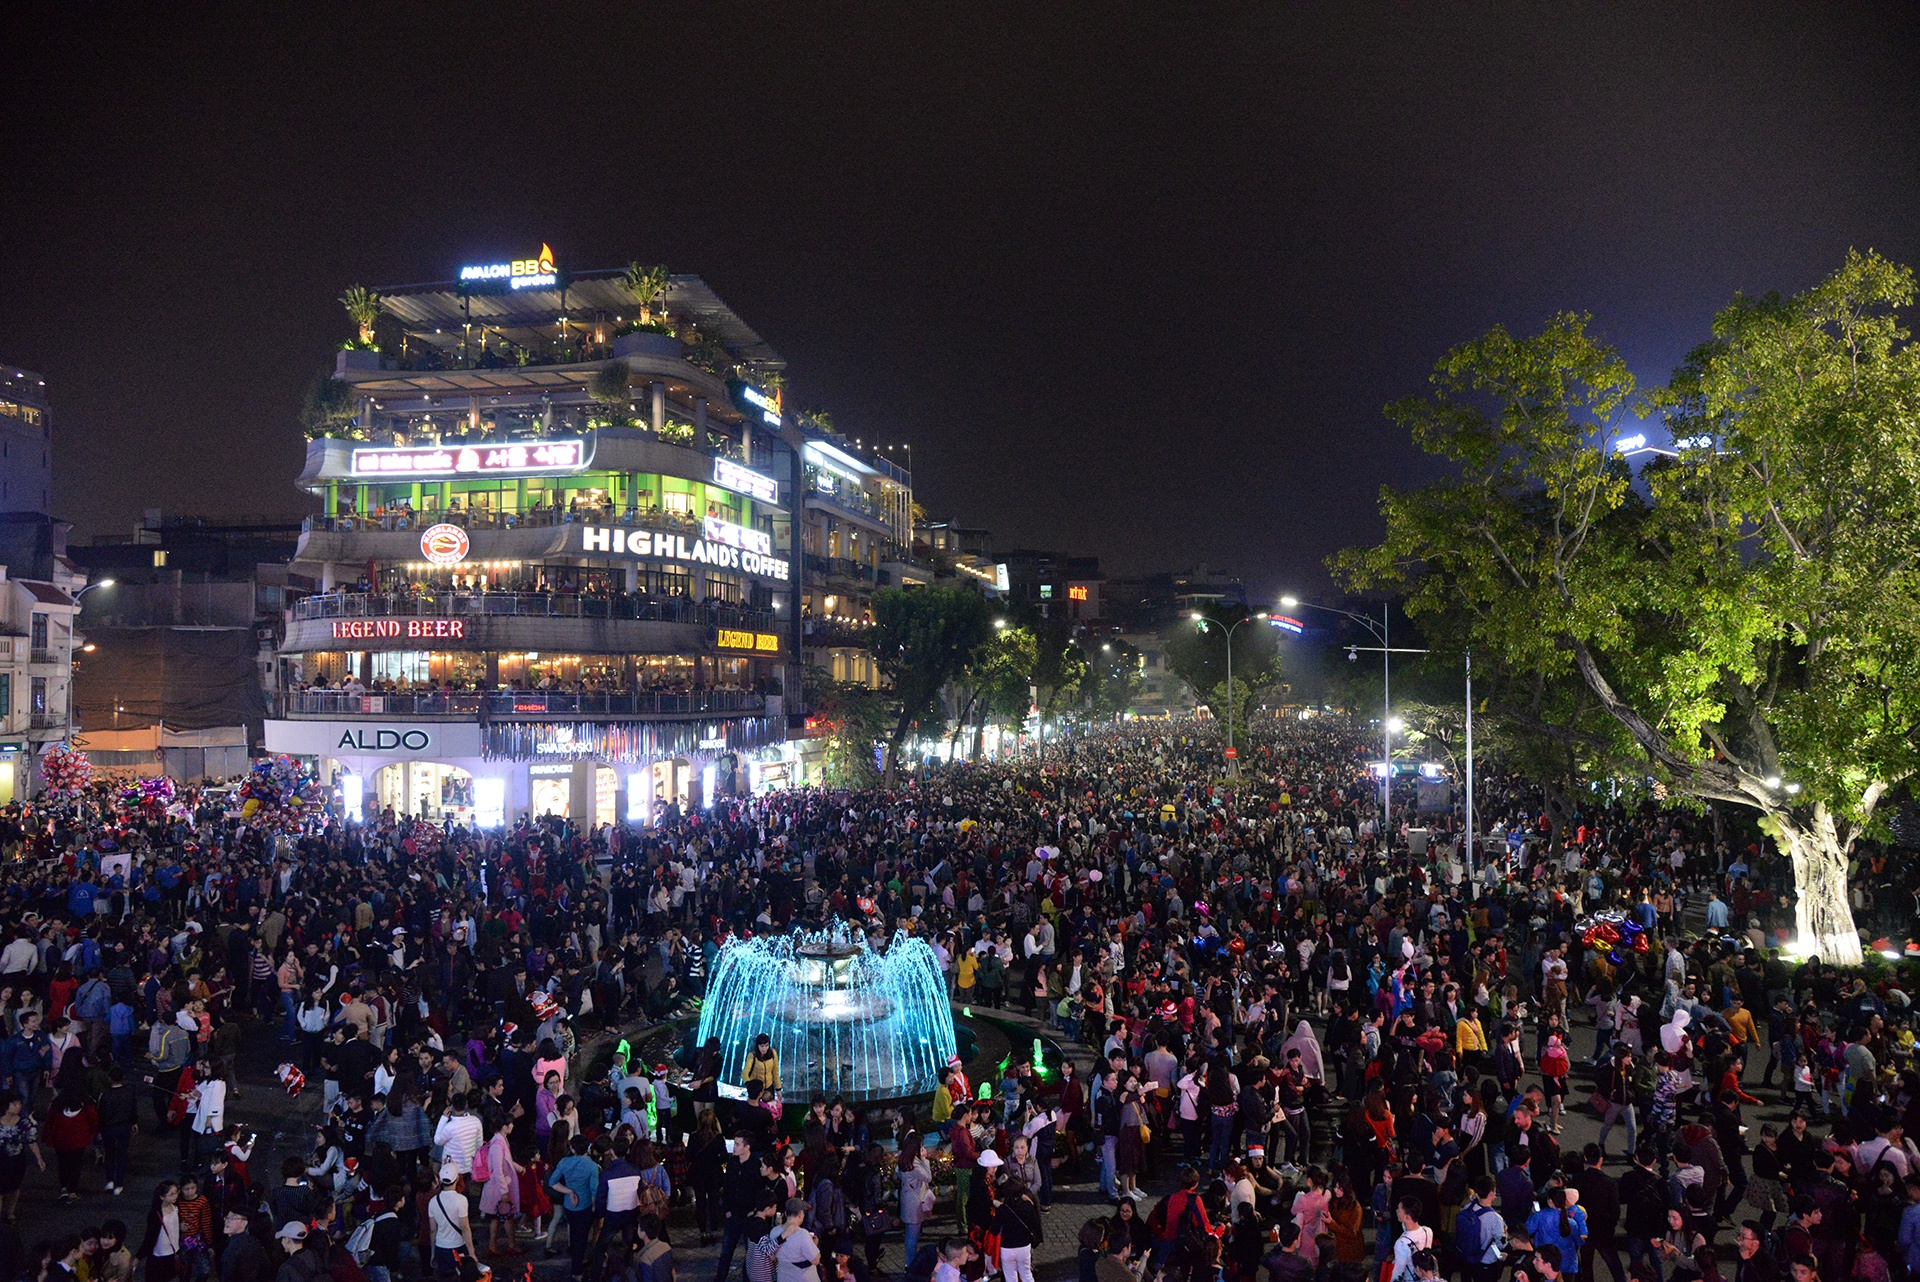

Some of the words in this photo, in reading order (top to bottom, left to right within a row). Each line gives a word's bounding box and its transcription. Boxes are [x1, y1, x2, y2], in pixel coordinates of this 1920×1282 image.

[461, 265, 510, 279] AVALON
[511, 249, 558, 276] BBQ
[511, 275, 555, 290] garden
[423, 526, 467, 544] HIGHLANDS
[583, 527, 739, 568] HIGHLANDS
[741, 551, 789, 580] COFFEE
[332, 621, 401, 638] LEGEND
[408, 620, 463, 638] BEER
[717, 630, 755, 649] LEGEND
[338, 729, 430, 751] ALDO
[536, 743, 593, 753] SWAROVSKI
